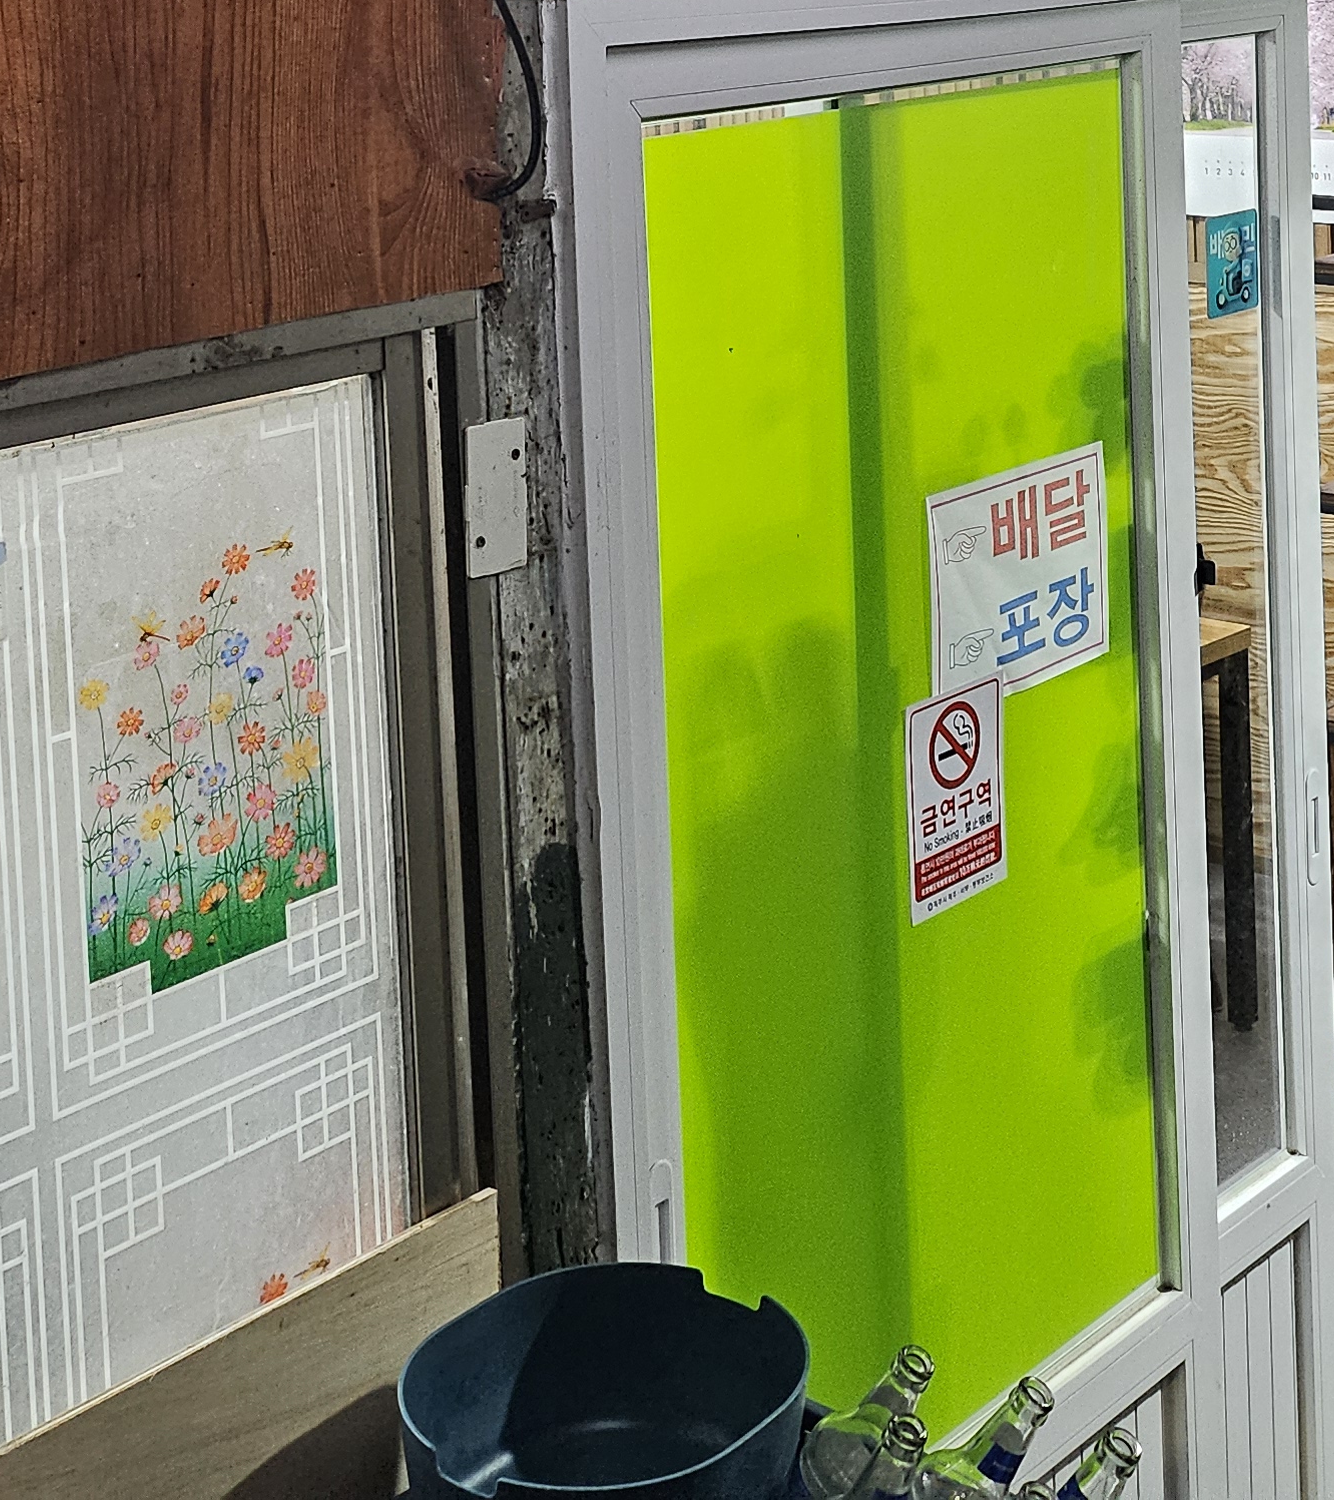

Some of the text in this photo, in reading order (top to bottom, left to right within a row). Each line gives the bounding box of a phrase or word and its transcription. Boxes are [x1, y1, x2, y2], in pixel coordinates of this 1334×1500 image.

[990, 468, 1091, 561] 배달
[996, 567, 1095, 667] 포장
[920, 778, 992, 838] 금연구역
